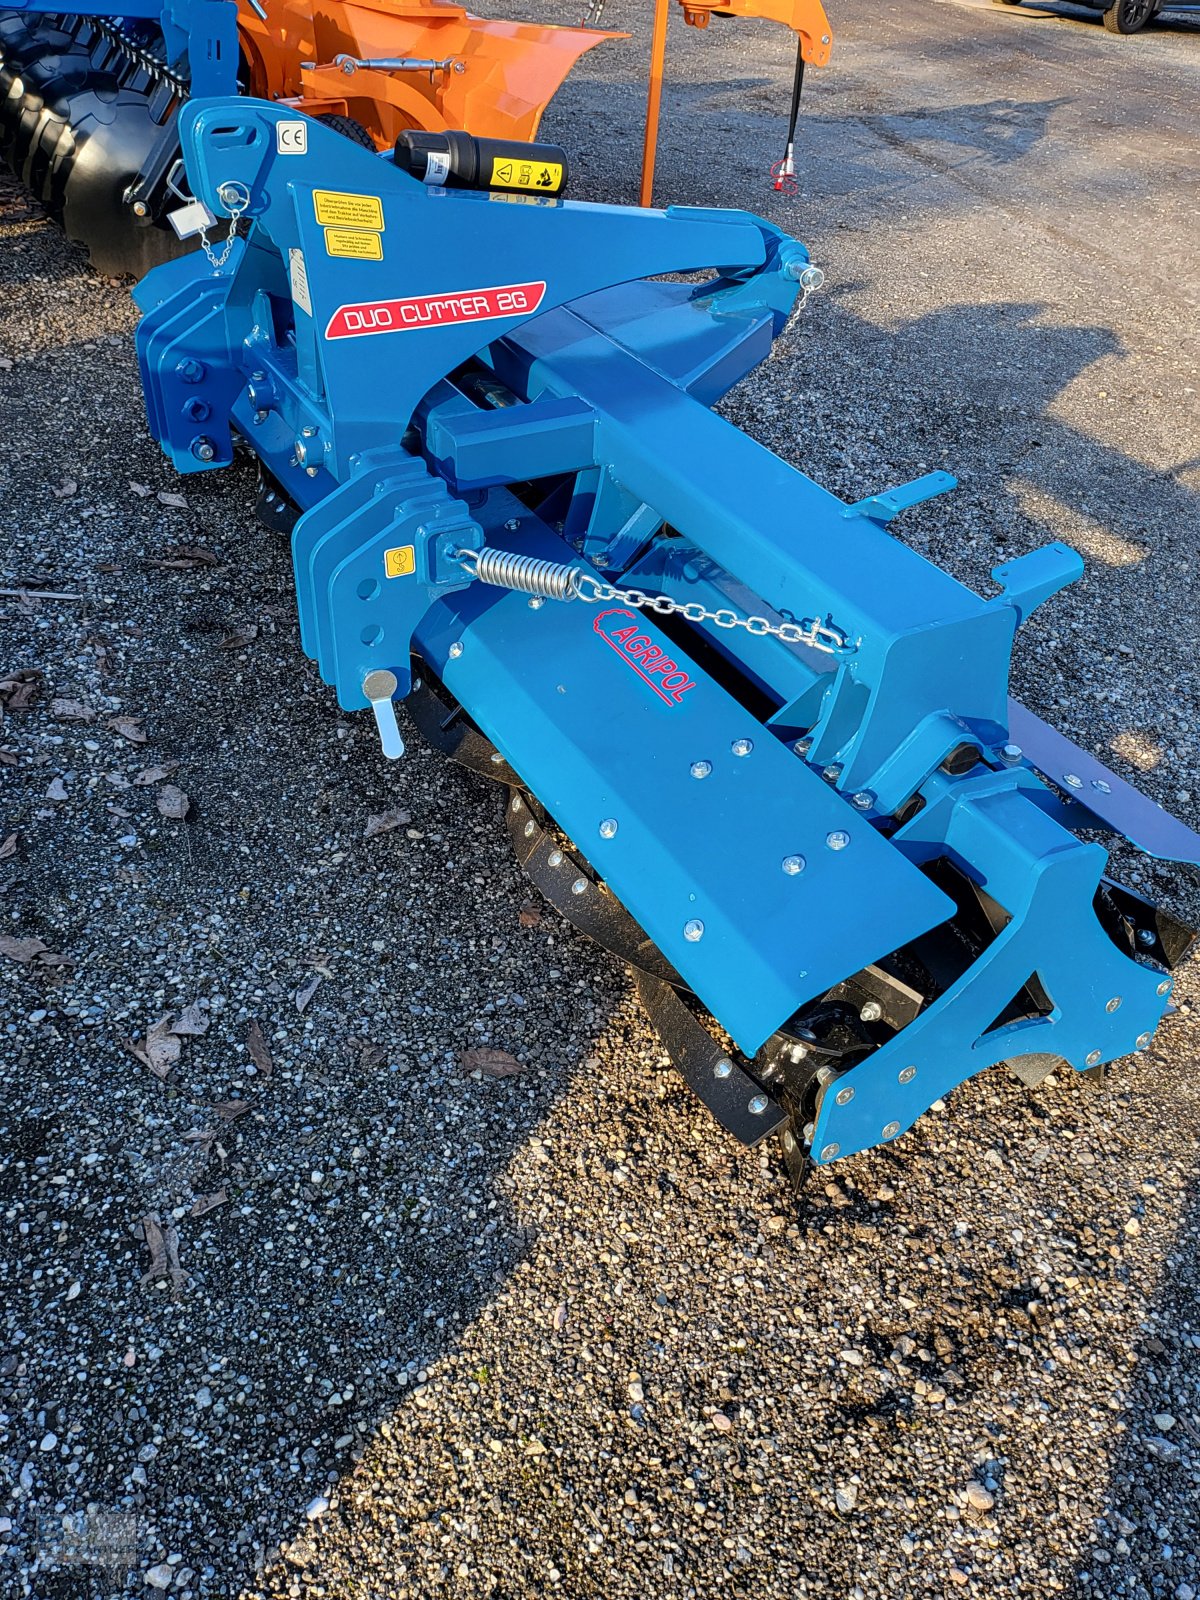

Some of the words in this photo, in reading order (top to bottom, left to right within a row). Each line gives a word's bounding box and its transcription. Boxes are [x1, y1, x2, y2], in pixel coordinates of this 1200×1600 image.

[281, 129, 303, 146] CE
[343, 308, 393, 331] DUO
[400, 296, 491, 324] CUTTER
[496, 291, 528, 311] 2G
[611, 625, 696, 704] AGRIPOL
